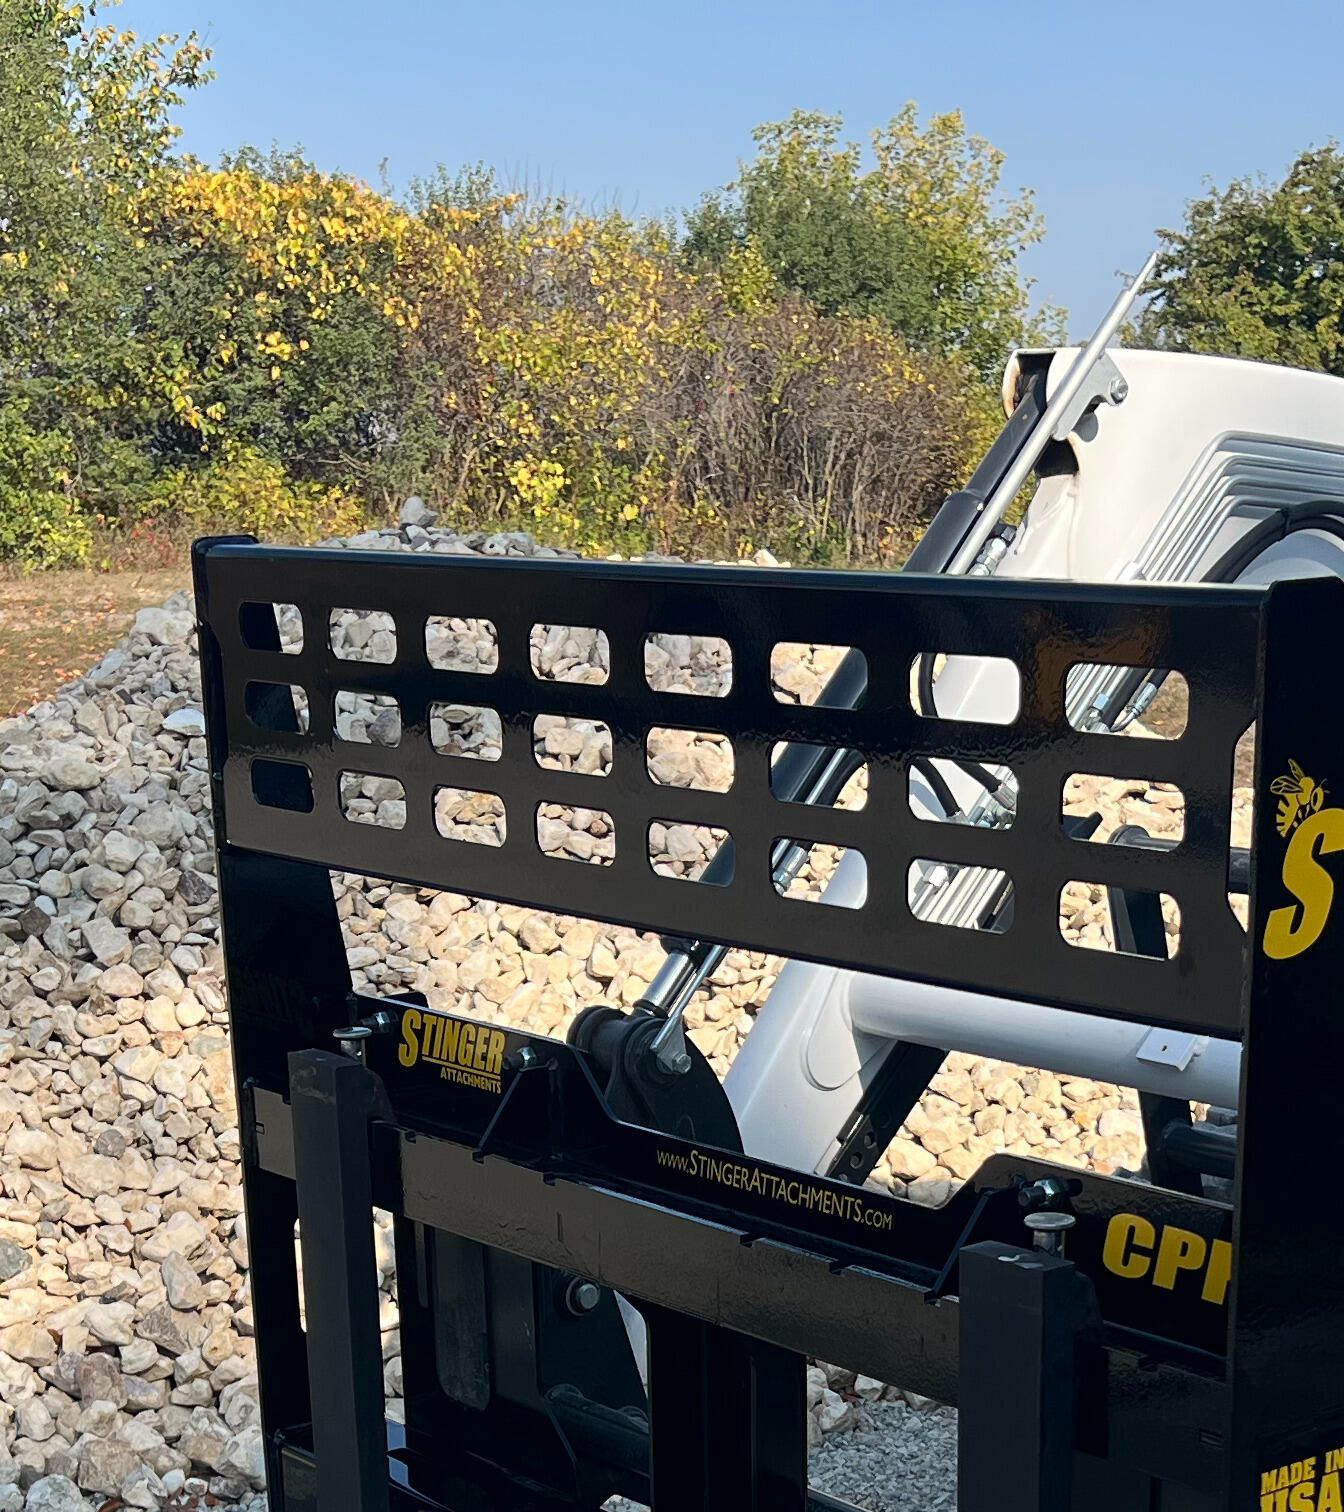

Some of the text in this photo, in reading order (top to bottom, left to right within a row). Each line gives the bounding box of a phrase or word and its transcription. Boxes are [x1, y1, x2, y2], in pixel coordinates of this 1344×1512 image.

[398, 1008, 506, 1075] STINGER
[440, 1065, 502, 1094] ATTACHMENTS
[1261, 1456, 1317, 1495] MADE
